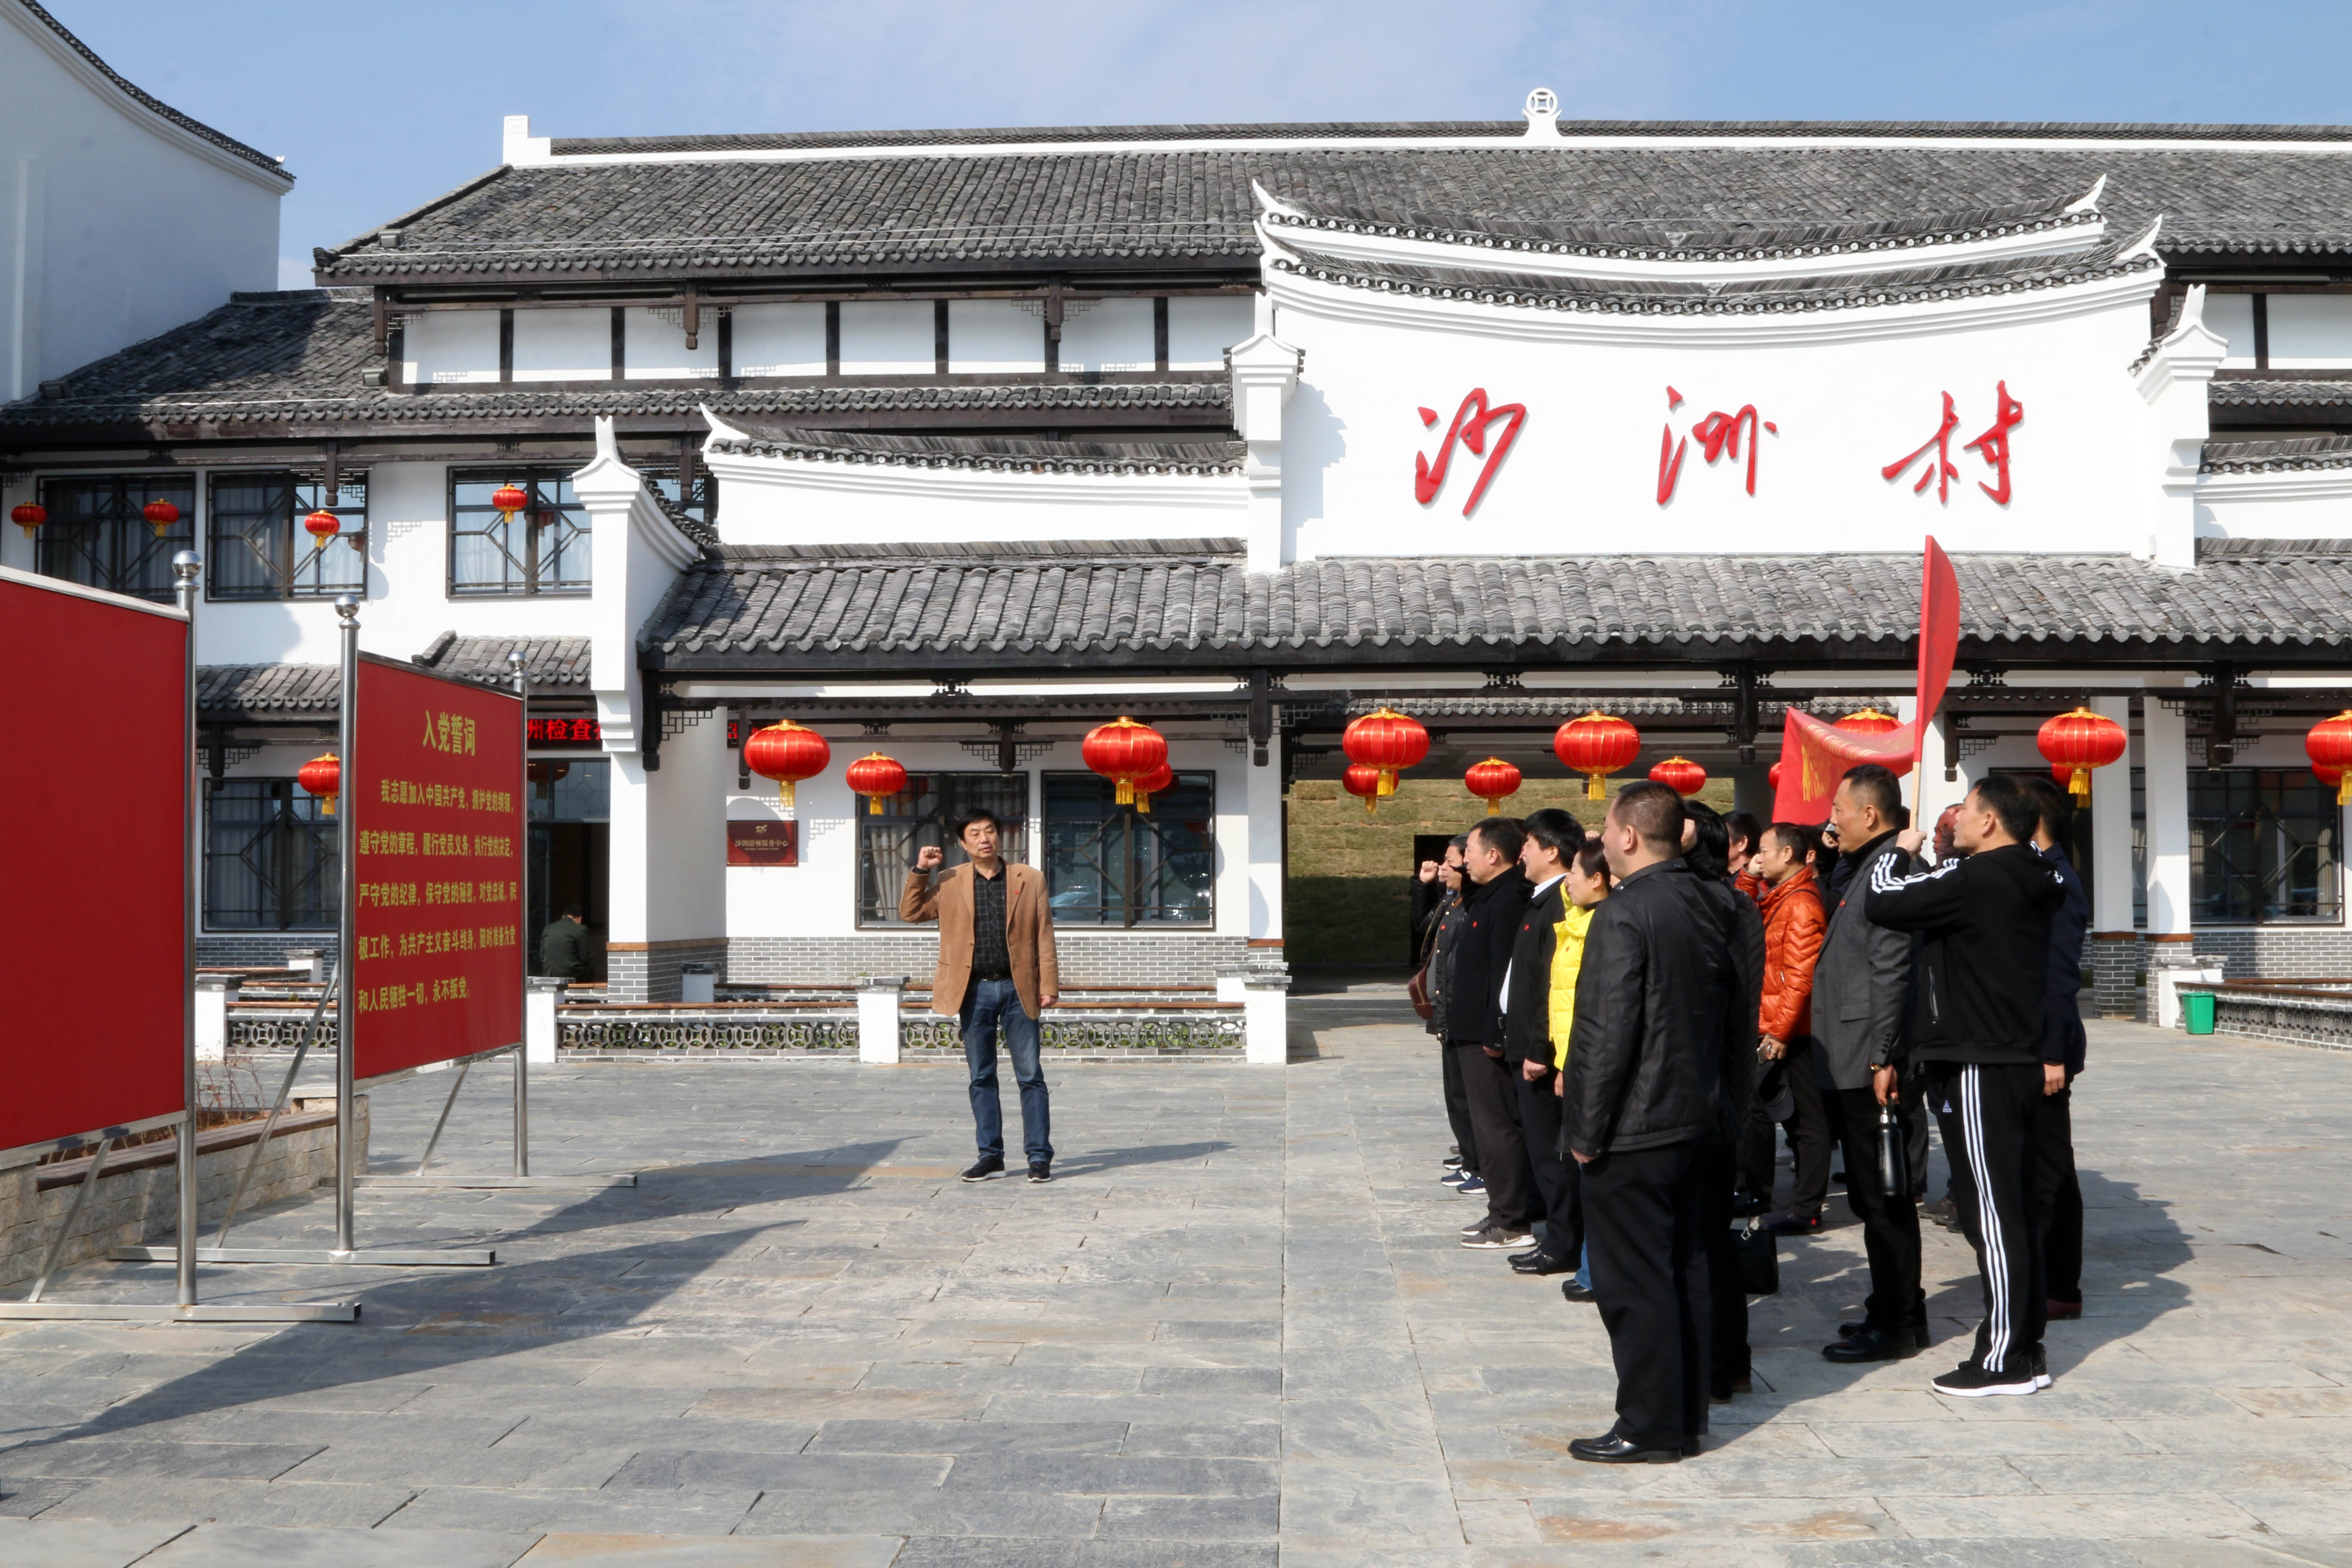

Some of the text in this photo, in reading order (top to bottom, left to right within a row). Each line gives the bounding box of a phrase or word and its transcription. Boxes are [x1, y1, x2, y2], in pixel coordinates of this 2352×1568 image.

[1415, 380, 2023, 515] 沙洲村
[423, 710, 475, 756] 入党誓词
